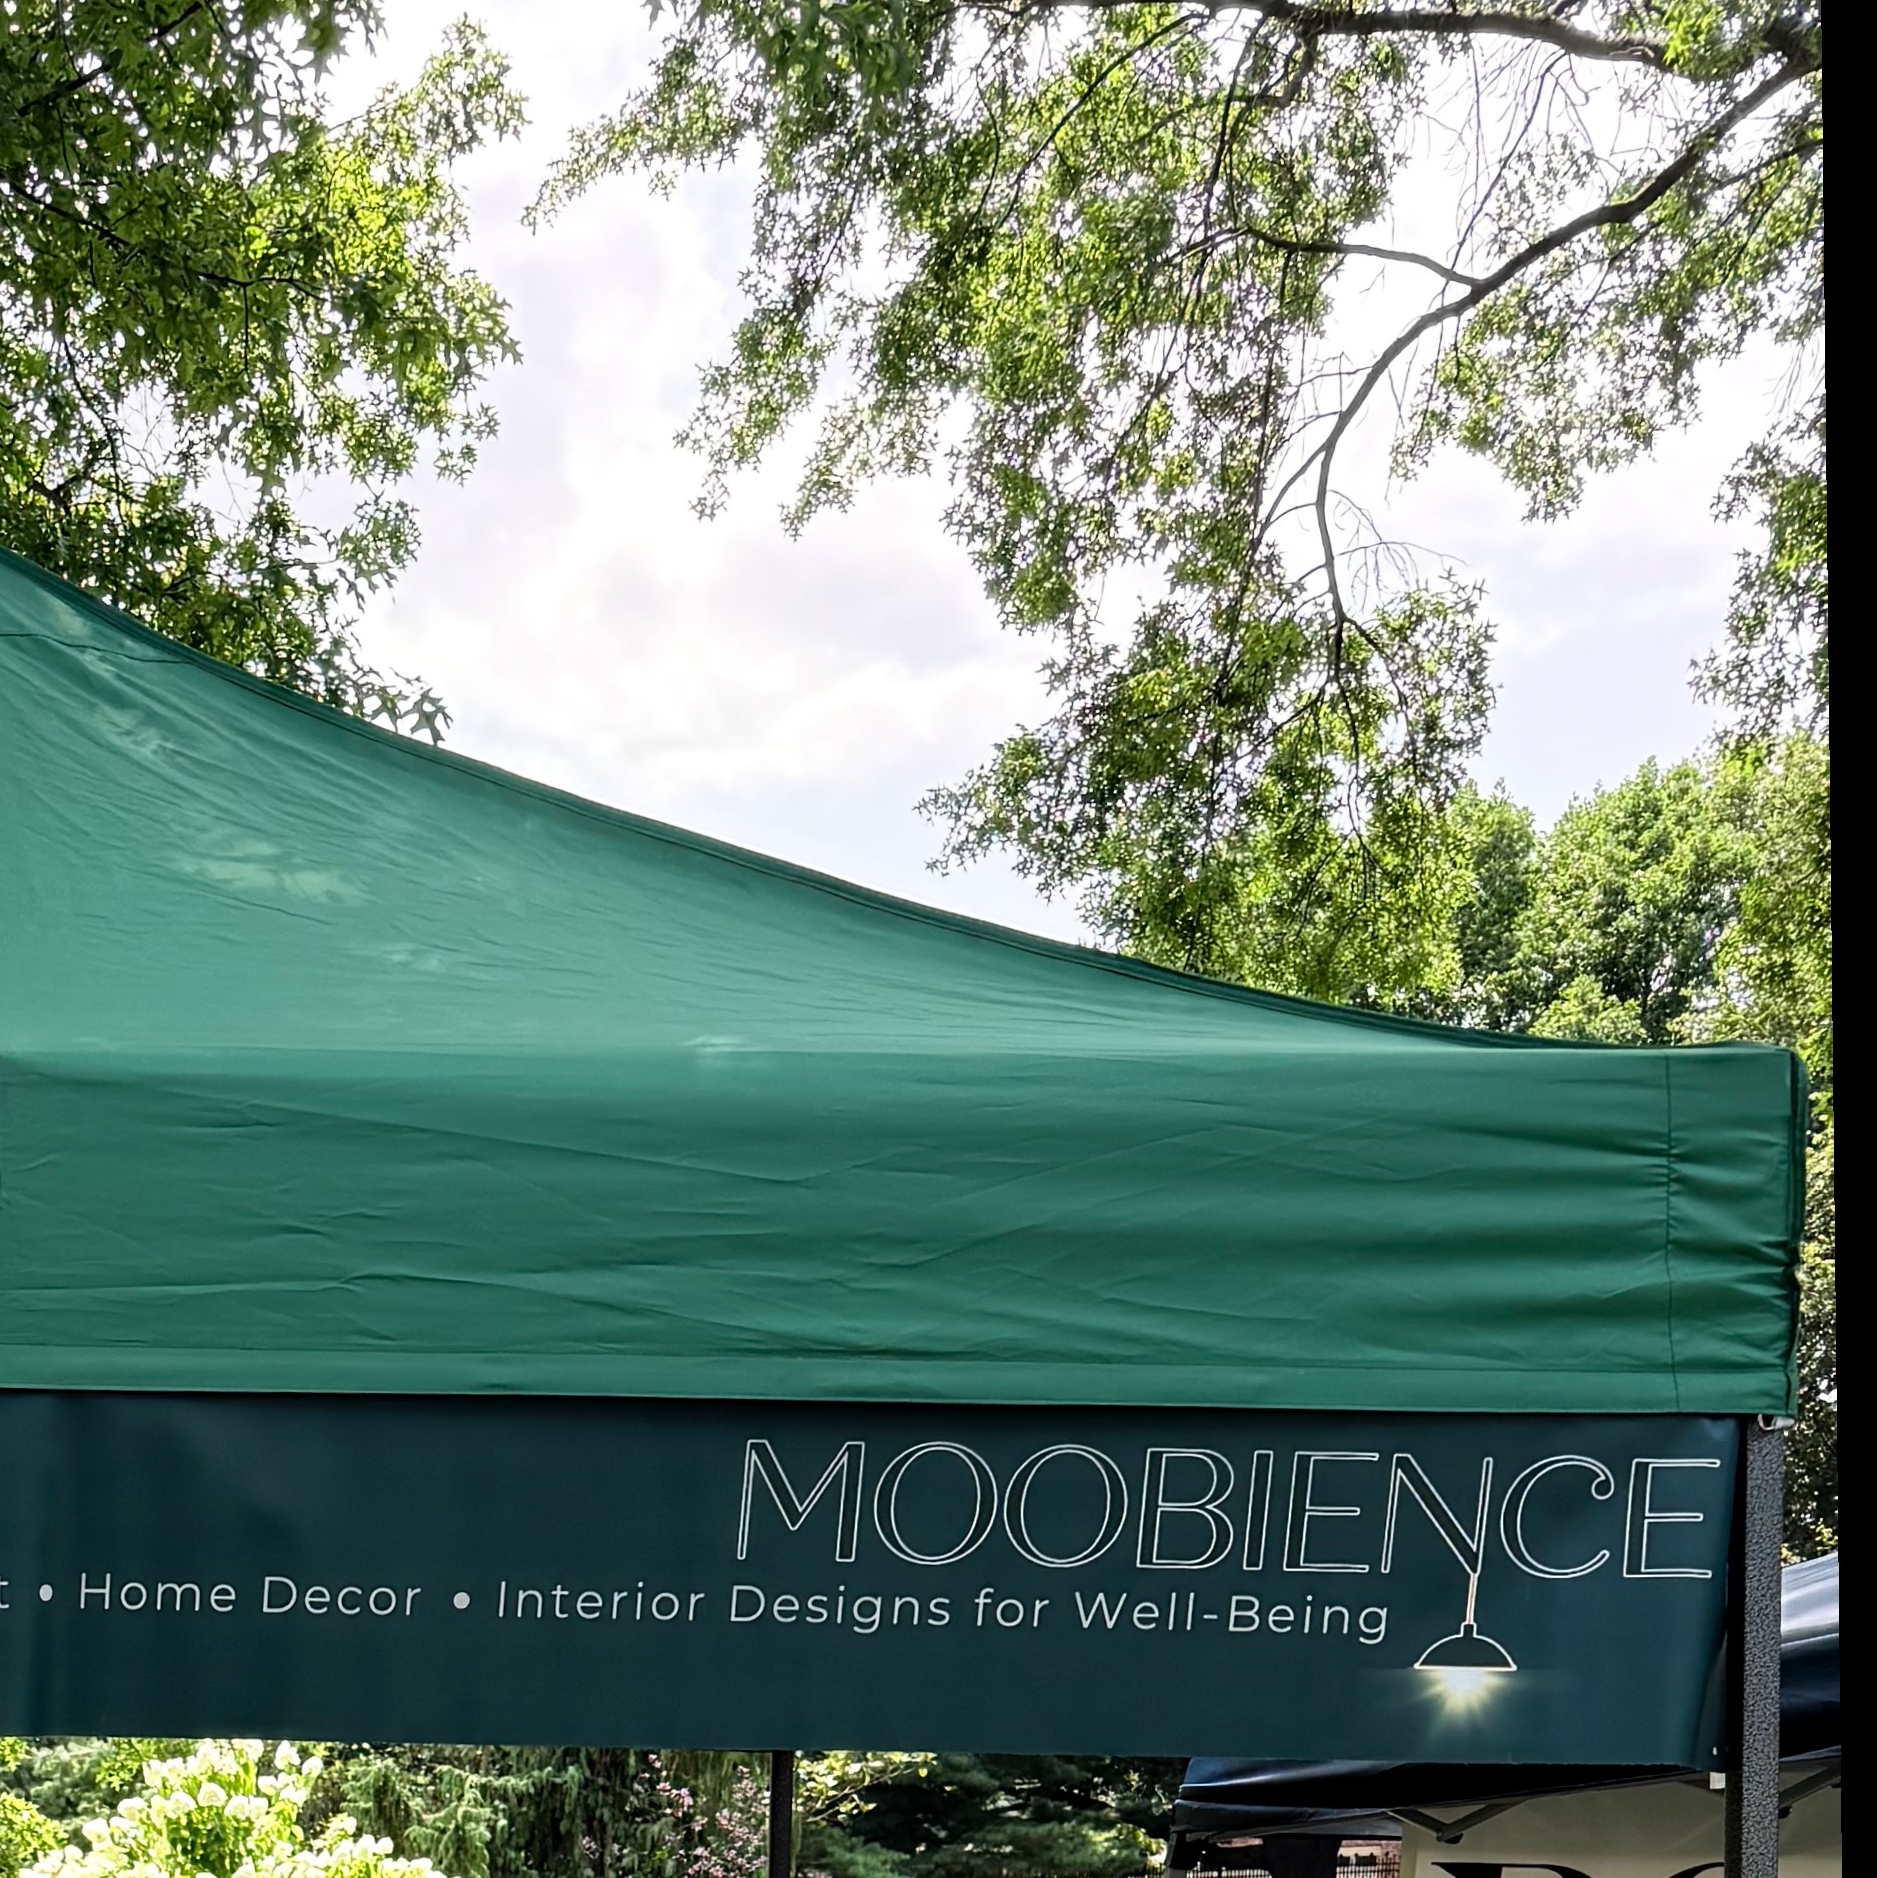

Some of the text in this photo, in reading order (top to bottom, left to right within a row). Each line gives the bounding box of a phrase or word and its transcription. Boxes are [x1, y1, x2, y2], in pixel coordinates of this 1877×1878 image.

[738, 1438, 1720, 1580] MOOBIENCE
[79, 1572, 236, 1612] Home
[262, 1575, 422, 1616] Decor
[498, 1580, 705, 1621] Interior
[729, 1584, 950, 1634] Designs
[974, 1588, 1049, 1627] for
[1074, 1591, 1389, 1644] Well-Being
